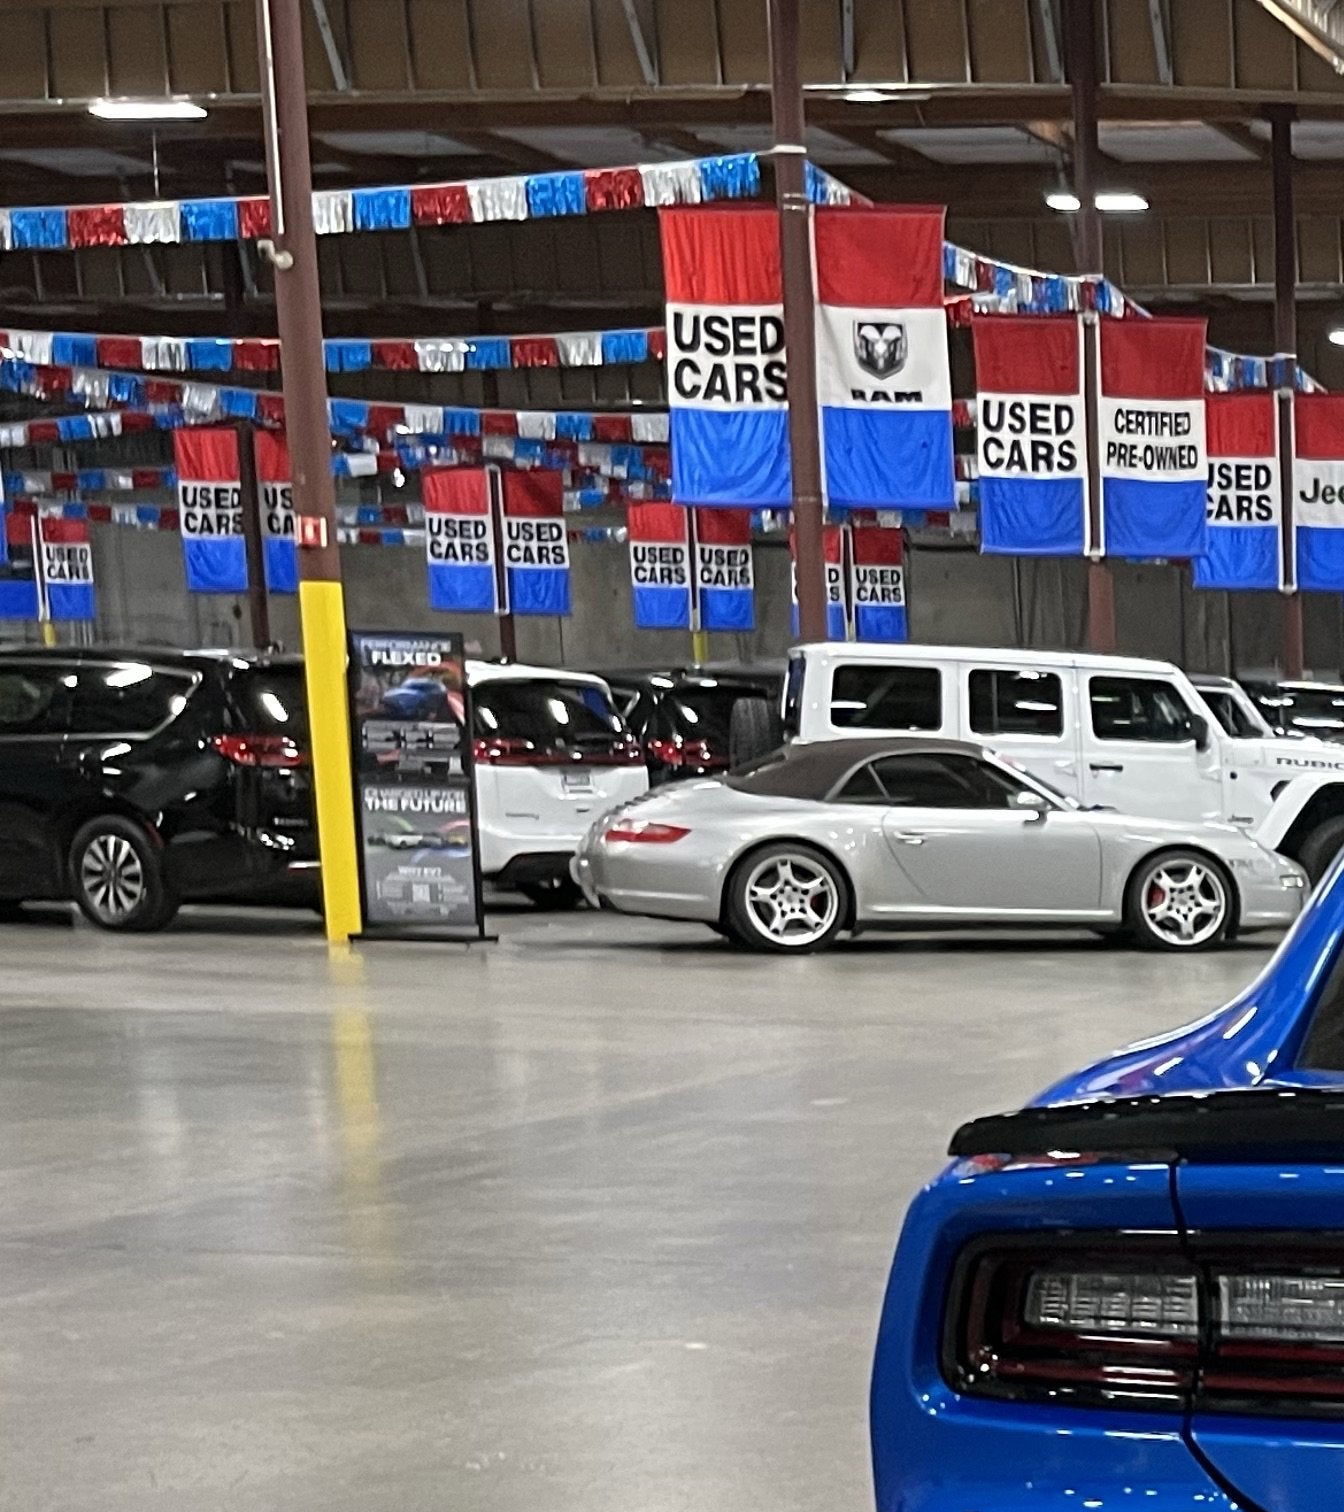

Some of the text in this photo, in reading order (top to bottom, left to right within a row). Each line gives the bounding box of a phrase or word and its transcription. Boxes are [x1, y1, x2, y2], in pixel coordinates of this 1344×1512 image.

[673, 312, 785, 356] USED
[674, 358, 787, 403] CARS
[982, 400, 1075, 436] USED
[1114, 408, 1192, 437] CERTIFIED
[982, 437, 1078, 472] CARS
[1106, 441, 1199, 471] PRE-OWNED
[182, 485, 240, 509] USED
[264, 488, 293, 510] US
[267, 512, 294, 534] CA
[428, 517, 487, 539] USED
[507, 522, 563, 542] USED
[430, 541, 489, 562] CARS
[507, 544, 566, 564] CARS
[632, 546, 685, 565] USED
[700, 547, 749, 566] USED
[634, 566, 687, 585] CARS
[700, 567, 750, 586] CARS
[855, 567, 901, 585] USED
[856, 584, 901, 602] CARS
[371, 650, 441, 666] FLEXED
[401, 798, 466, 813] FUTURE
